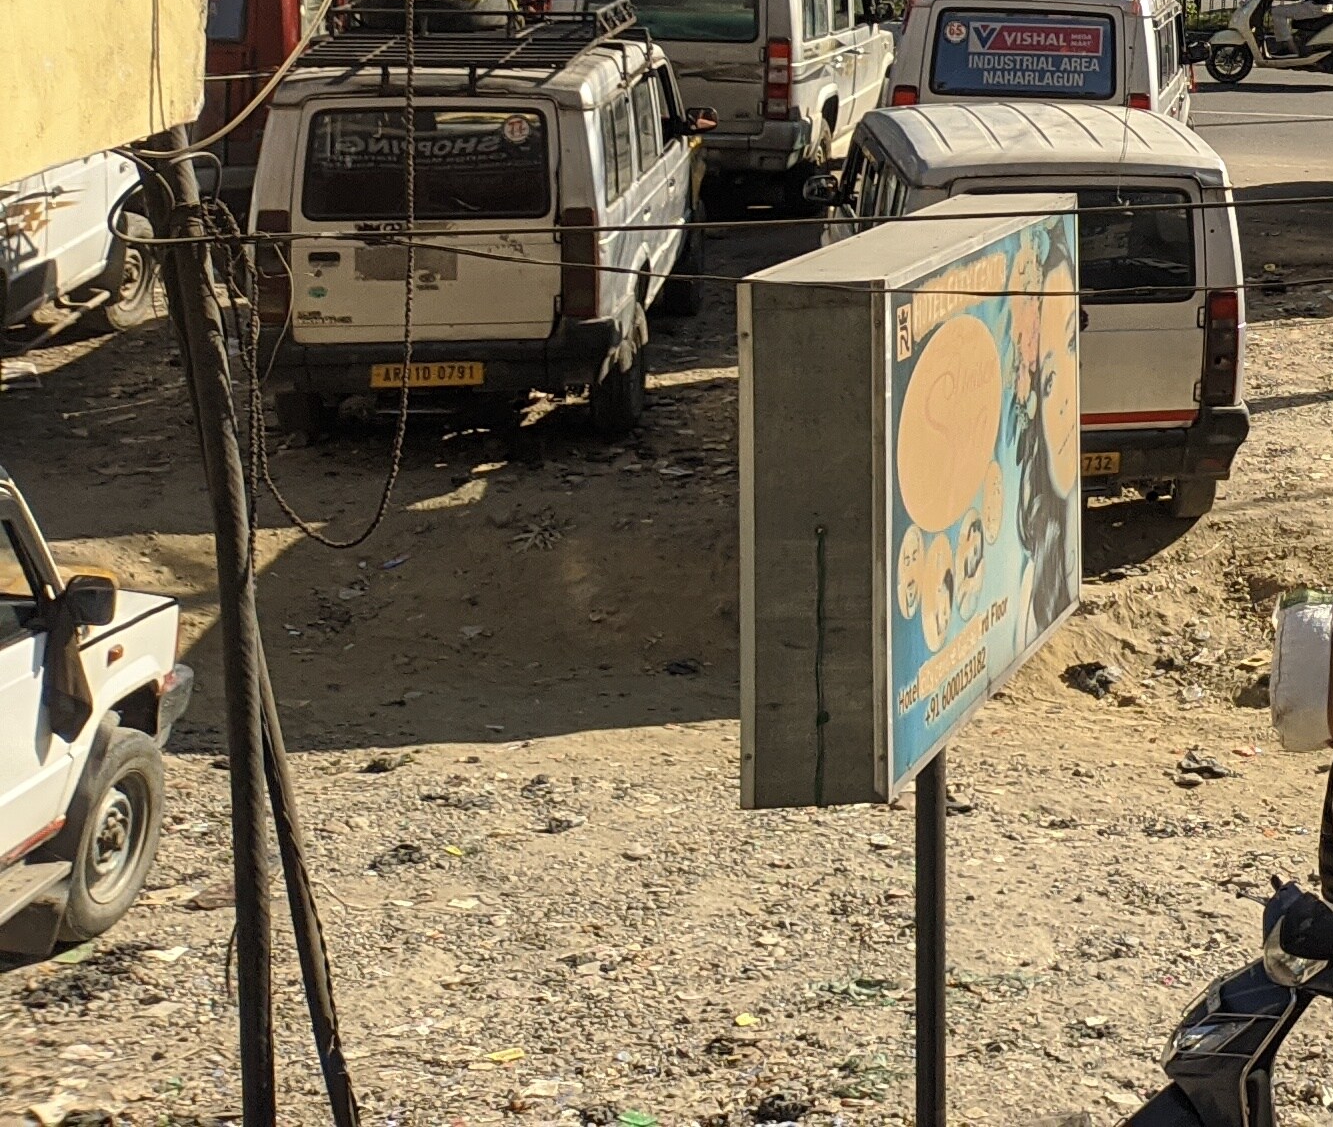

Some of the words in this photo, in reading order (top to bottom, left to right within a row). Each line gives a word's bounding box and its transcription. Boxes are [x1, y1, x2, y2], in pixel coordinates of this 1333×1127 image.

[949, 24, 964, 36] 65
[1003, 31, 1067, 47] VISHAL
[968, 54, 1056, 70] INDUSTRIAL
[1060, 57, 1100, 72] AREA
[982, 72, 1084, 87] NAHARLAGUN
[991, 596, 1009, 625] Floor
[925, 693, 940, 723] +91
